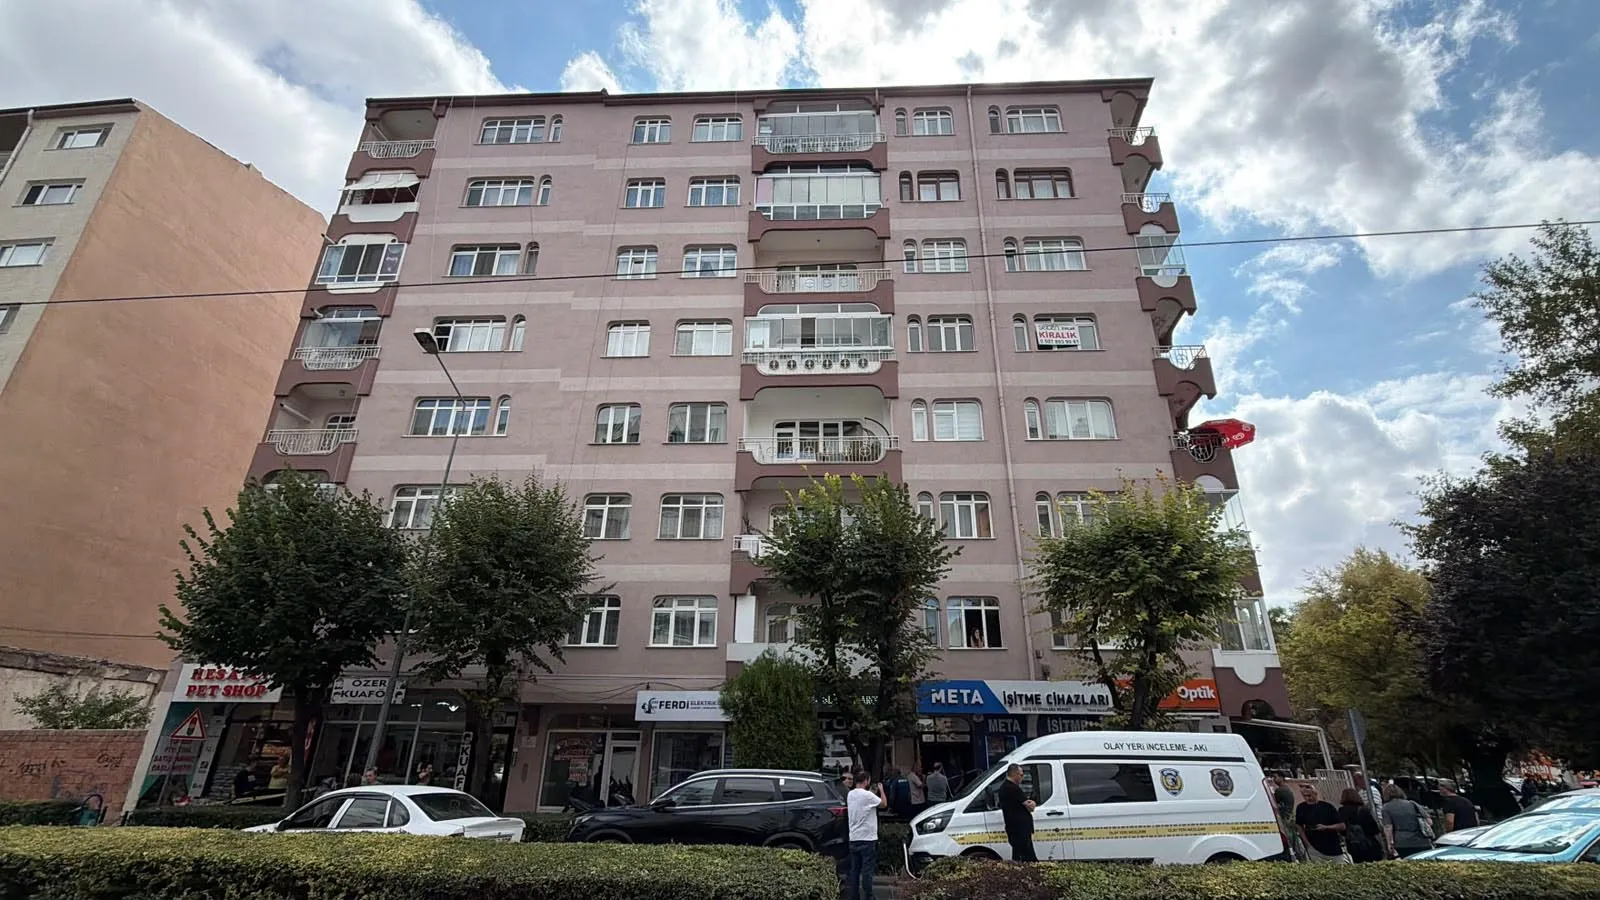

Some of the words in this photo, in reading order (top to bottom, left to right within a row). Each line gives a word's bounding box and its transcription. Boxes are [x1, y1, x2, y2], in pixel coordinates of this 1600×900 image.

[186, 685, 220, 697] PET
[222, 685, 267, 697] SHOP
[931, 688, 985, 704] META
[1003, 690, 1042, 706] İŞİTME
[1046, 691, 1110, 706] CİHAZLARI
[1177, 685, 1216, 702] Optik
[988, 719, 1022, 733] META
[1103, 742, 1124, 751] OLAY
